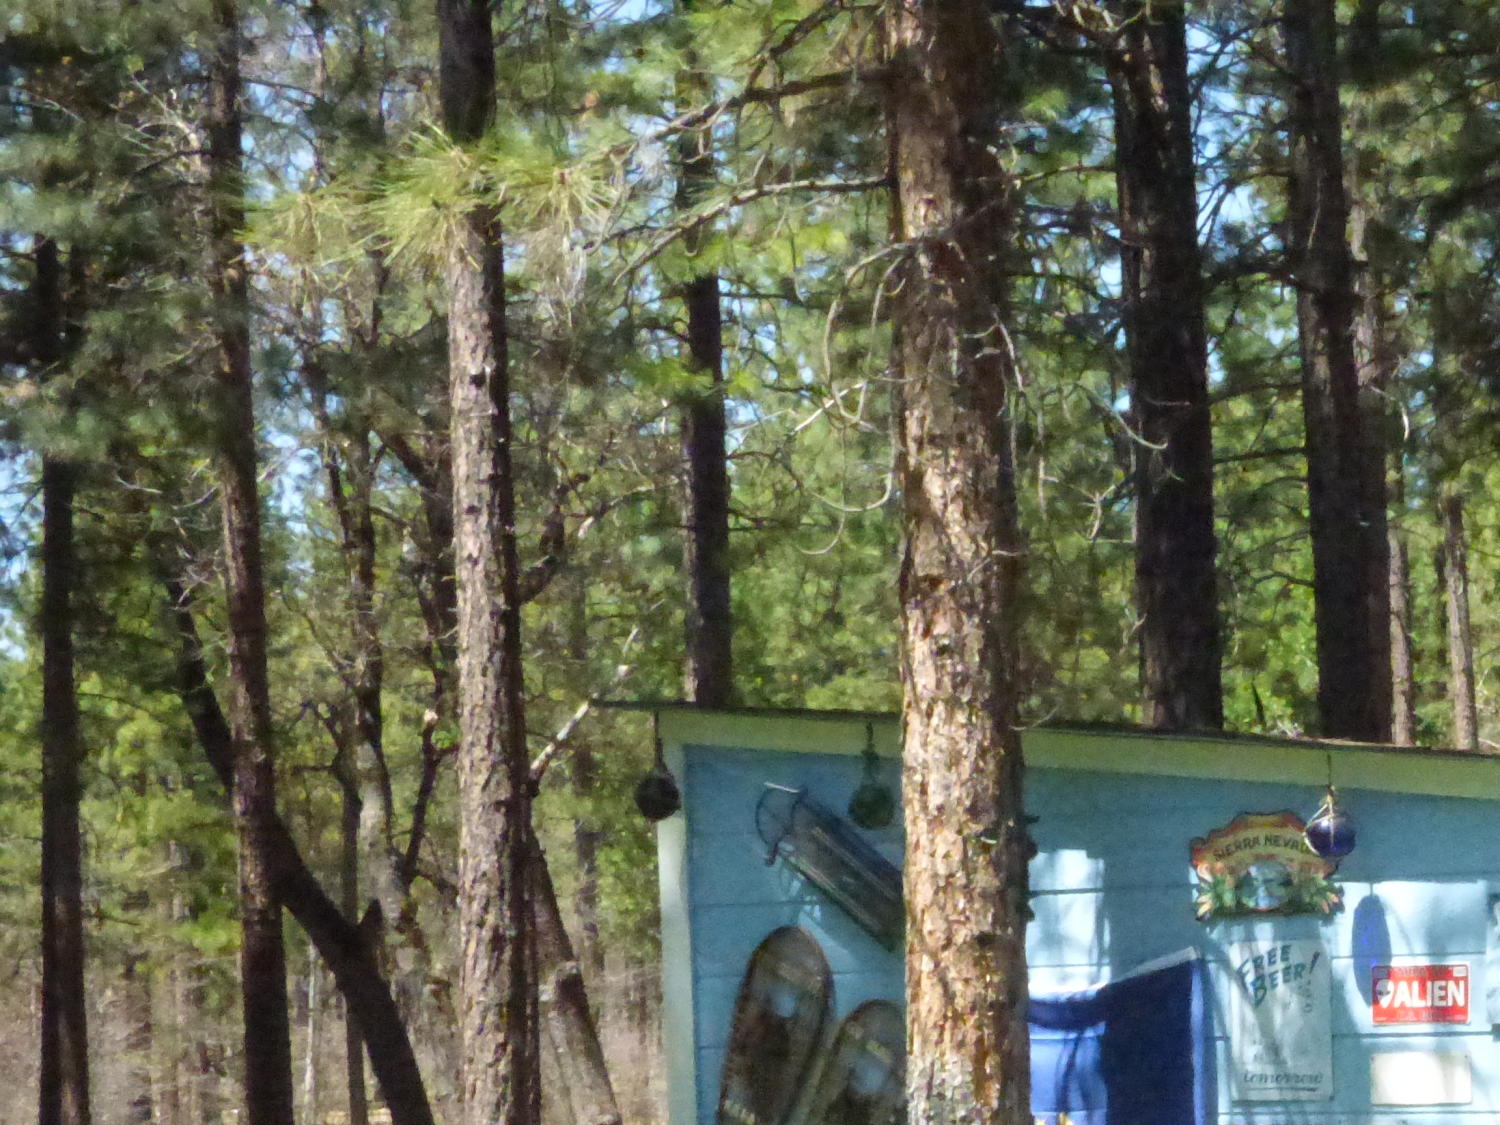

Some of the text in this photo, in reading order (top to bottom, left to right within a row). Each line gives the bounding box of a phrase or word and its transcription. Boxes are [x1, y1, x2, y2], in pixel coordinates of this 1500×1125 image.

[1265, 833, 1309, 853] NEVA
[1237, 944, 1292, 990] FREE
[1250, 951, 1320, 1008] BEER!
[1393, 980, 1465, 1008] ALIEN
